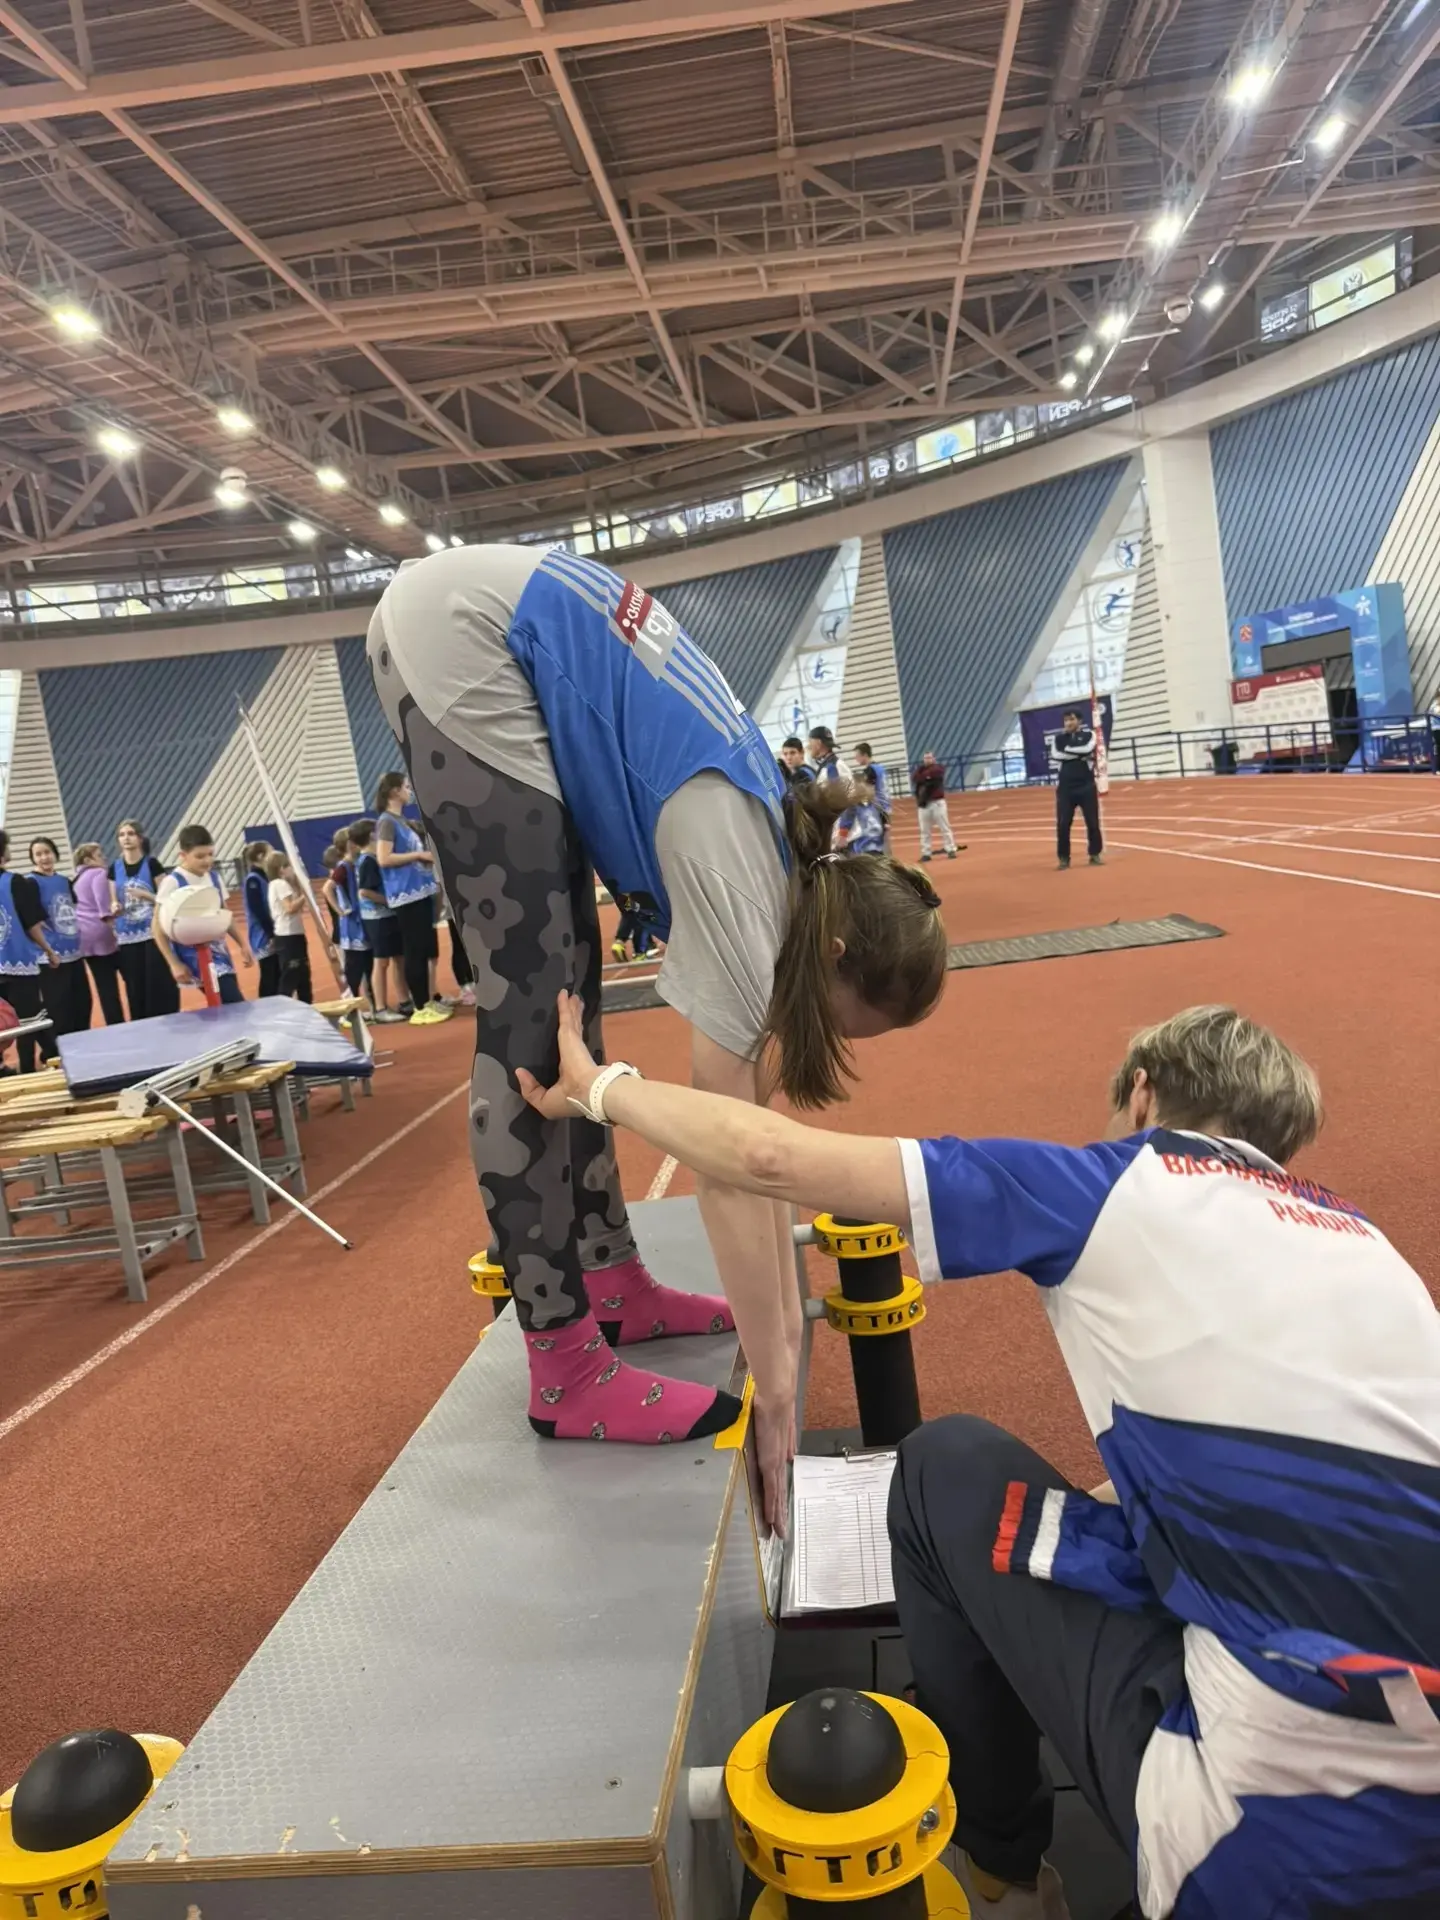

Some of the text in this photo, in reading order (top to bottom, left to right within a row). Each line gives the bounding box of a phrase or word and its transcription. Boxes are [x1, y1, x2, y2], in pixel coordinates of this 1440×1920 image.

[836, 1234, 892, 1251] ГТО
[482, 1277, 510, 1289] ГТ
[847, 1311, 903, 1328] ГТО
[772, 1841, 903, 1884] ГТО
[12, 1878, 99, 1918] ТО
